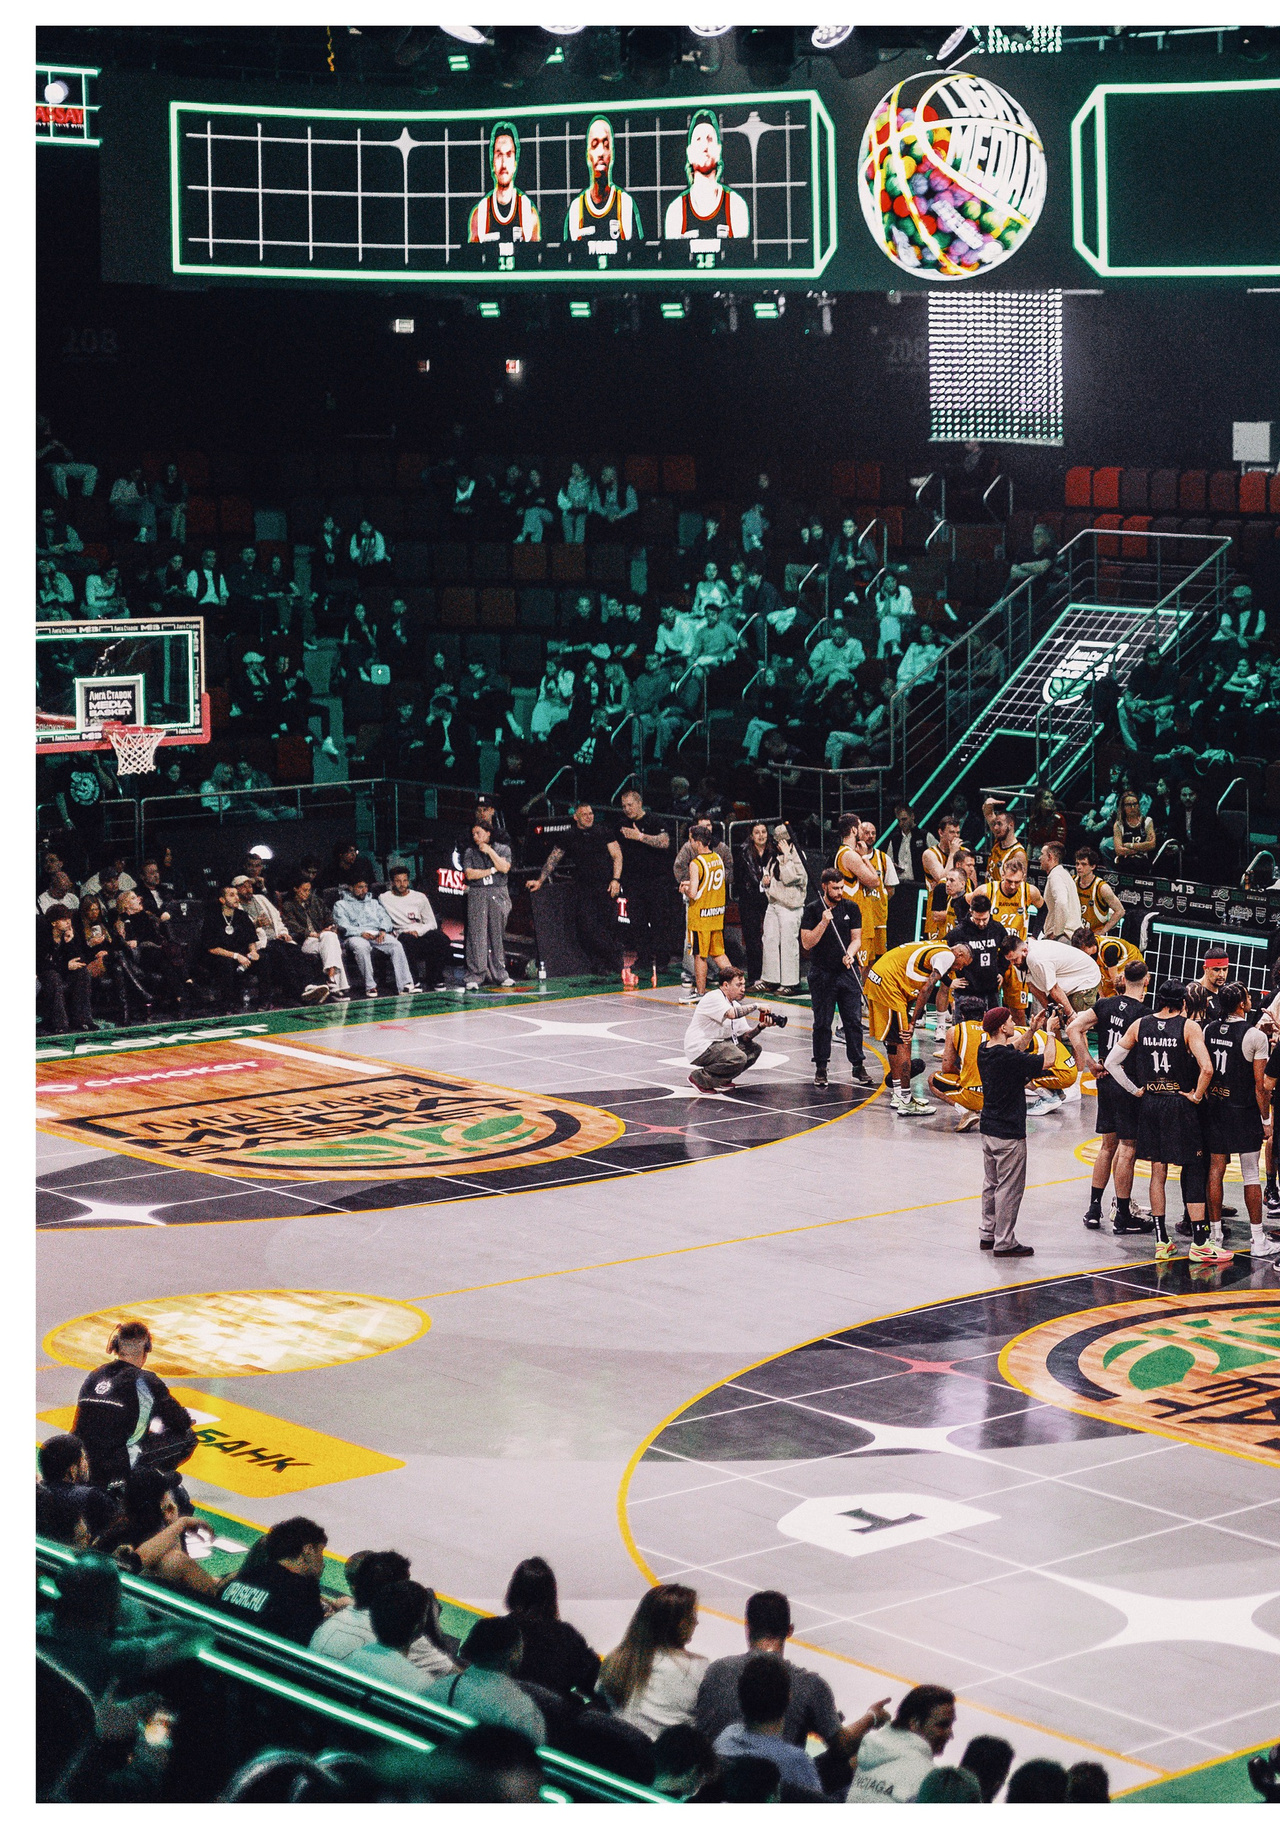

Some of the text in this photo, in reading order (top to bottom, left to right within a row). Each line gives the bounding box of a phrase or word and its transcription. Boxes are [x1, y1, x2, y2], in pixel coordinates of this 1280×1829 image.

[89, 700, 132, 709] MEDIA
[89, 709, 133, 717] BASKET
[707, 868, 724, 892] 19
[1000, 913, 1016, 925] 27
[84, 1060, 260, 1087] самокат
[1151, 1050, 1171, 1073] 14
[1147, 1083, 1180, 1091] KVASS
[139, 1087, 439, 1134] ЛИГА СТАВОК
[124, 1097, 508, 1149] MEDIA
[162, 1100, 525, 1158] BASKET
[196, 1428, 315, 1474] БАНК
